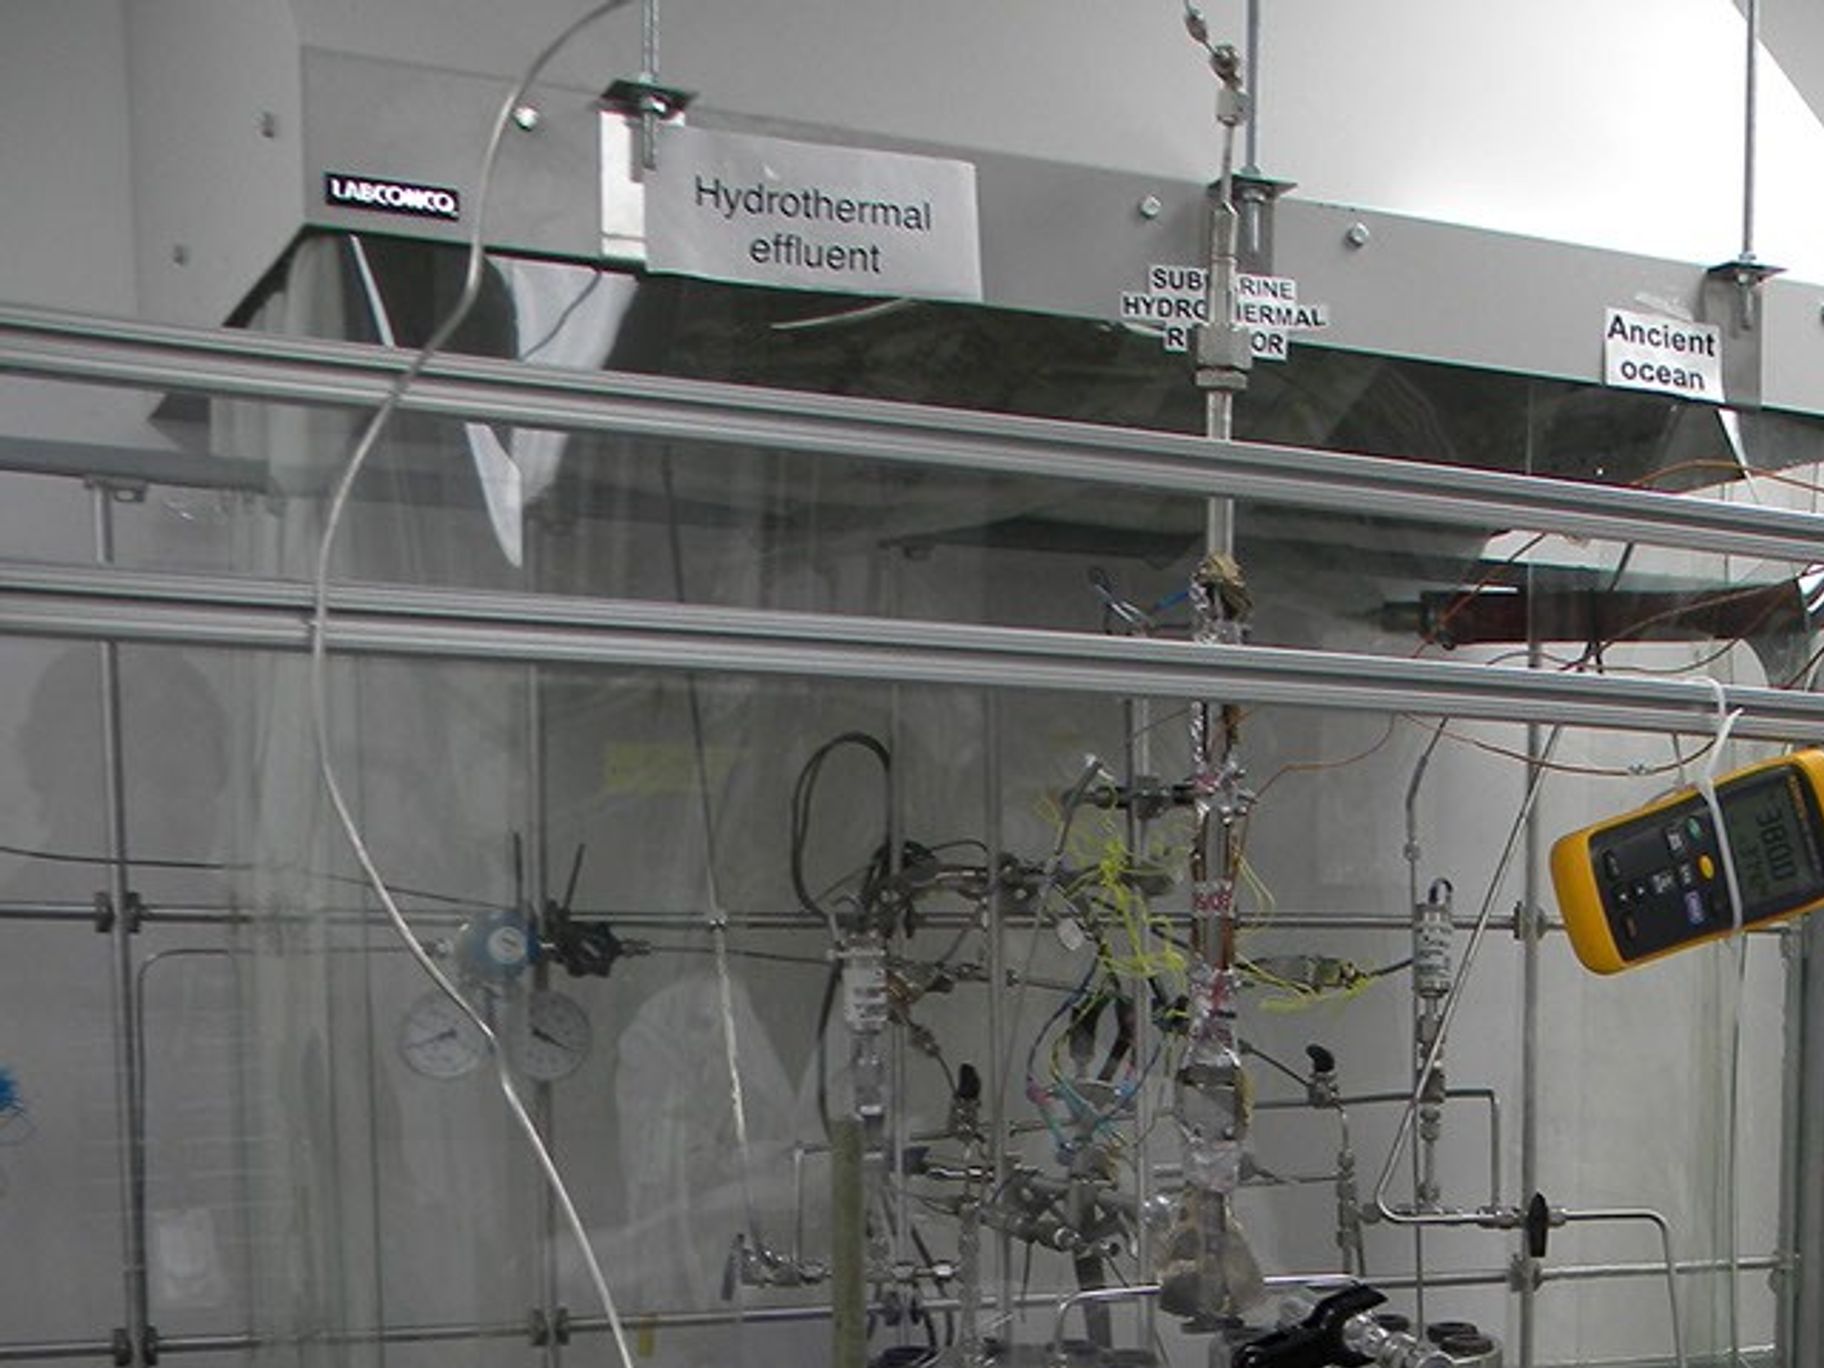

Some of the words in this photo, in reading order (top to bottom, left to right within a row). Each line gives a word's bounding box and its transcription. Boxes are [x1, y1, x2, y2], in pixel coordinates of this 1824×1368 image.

[694, 174, 932, 231] Hydrothermal
[749, 232, 882, 274] effluent
[1152, 267, 1294, 300] SUBRINE
[1123, 295, 1327, 327] HYDROERMAL
[1607, 313, 1715, 358] Ancient
[1620, 360, 1706, 390] ocean
